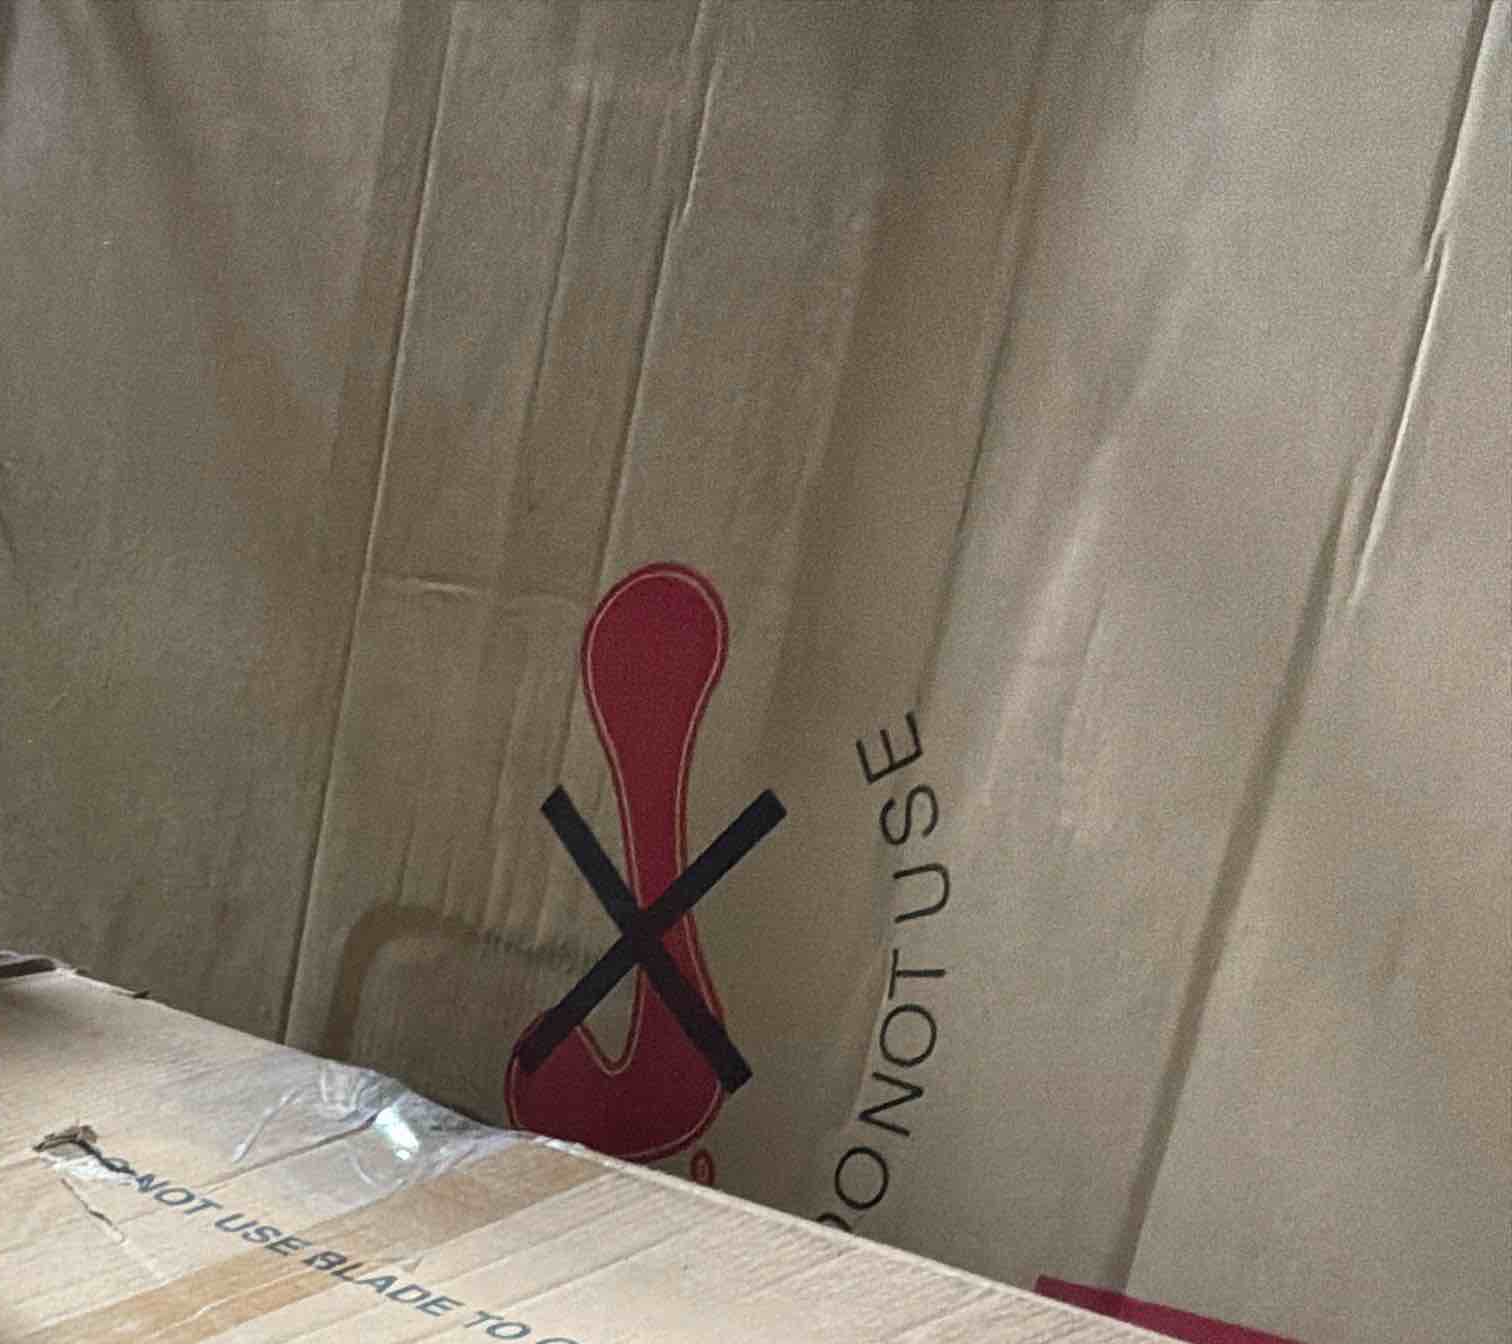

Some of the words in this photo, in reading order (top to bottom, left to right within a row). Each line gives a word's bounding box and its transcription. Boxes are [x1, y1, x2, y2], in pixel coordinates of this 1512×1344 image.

[136, 1172, 224, 1217] NOT
[213, 1212, 314, 1257] USE
[303, 1249, 465, 1318] BLADE
[461, 1308, 534, 1342] TO
